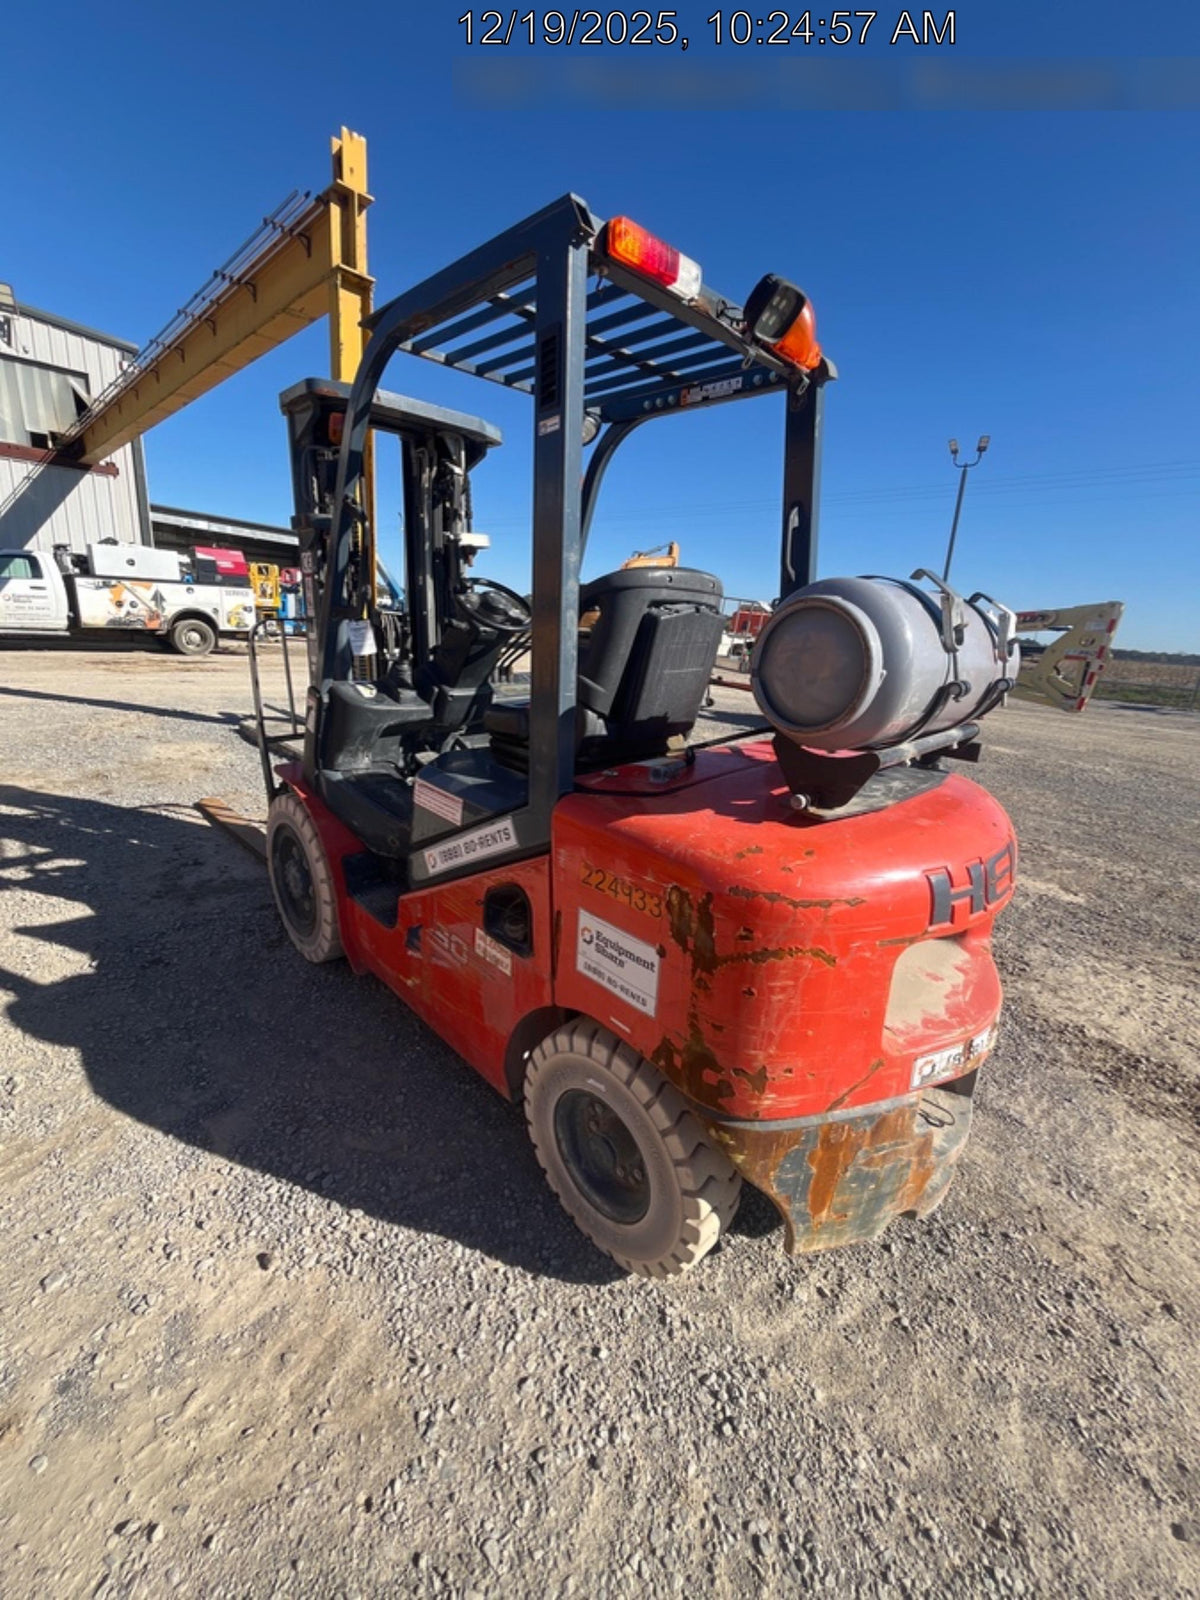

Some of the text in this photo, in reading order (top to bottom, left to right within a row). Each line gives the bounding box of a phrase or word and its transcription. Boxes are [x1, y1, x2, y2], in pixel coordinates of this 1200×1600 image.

[581, 863, 663, 919] 224933
[594, 929, 657, 973] Equipment
[594, 942, 625, 969] Share
